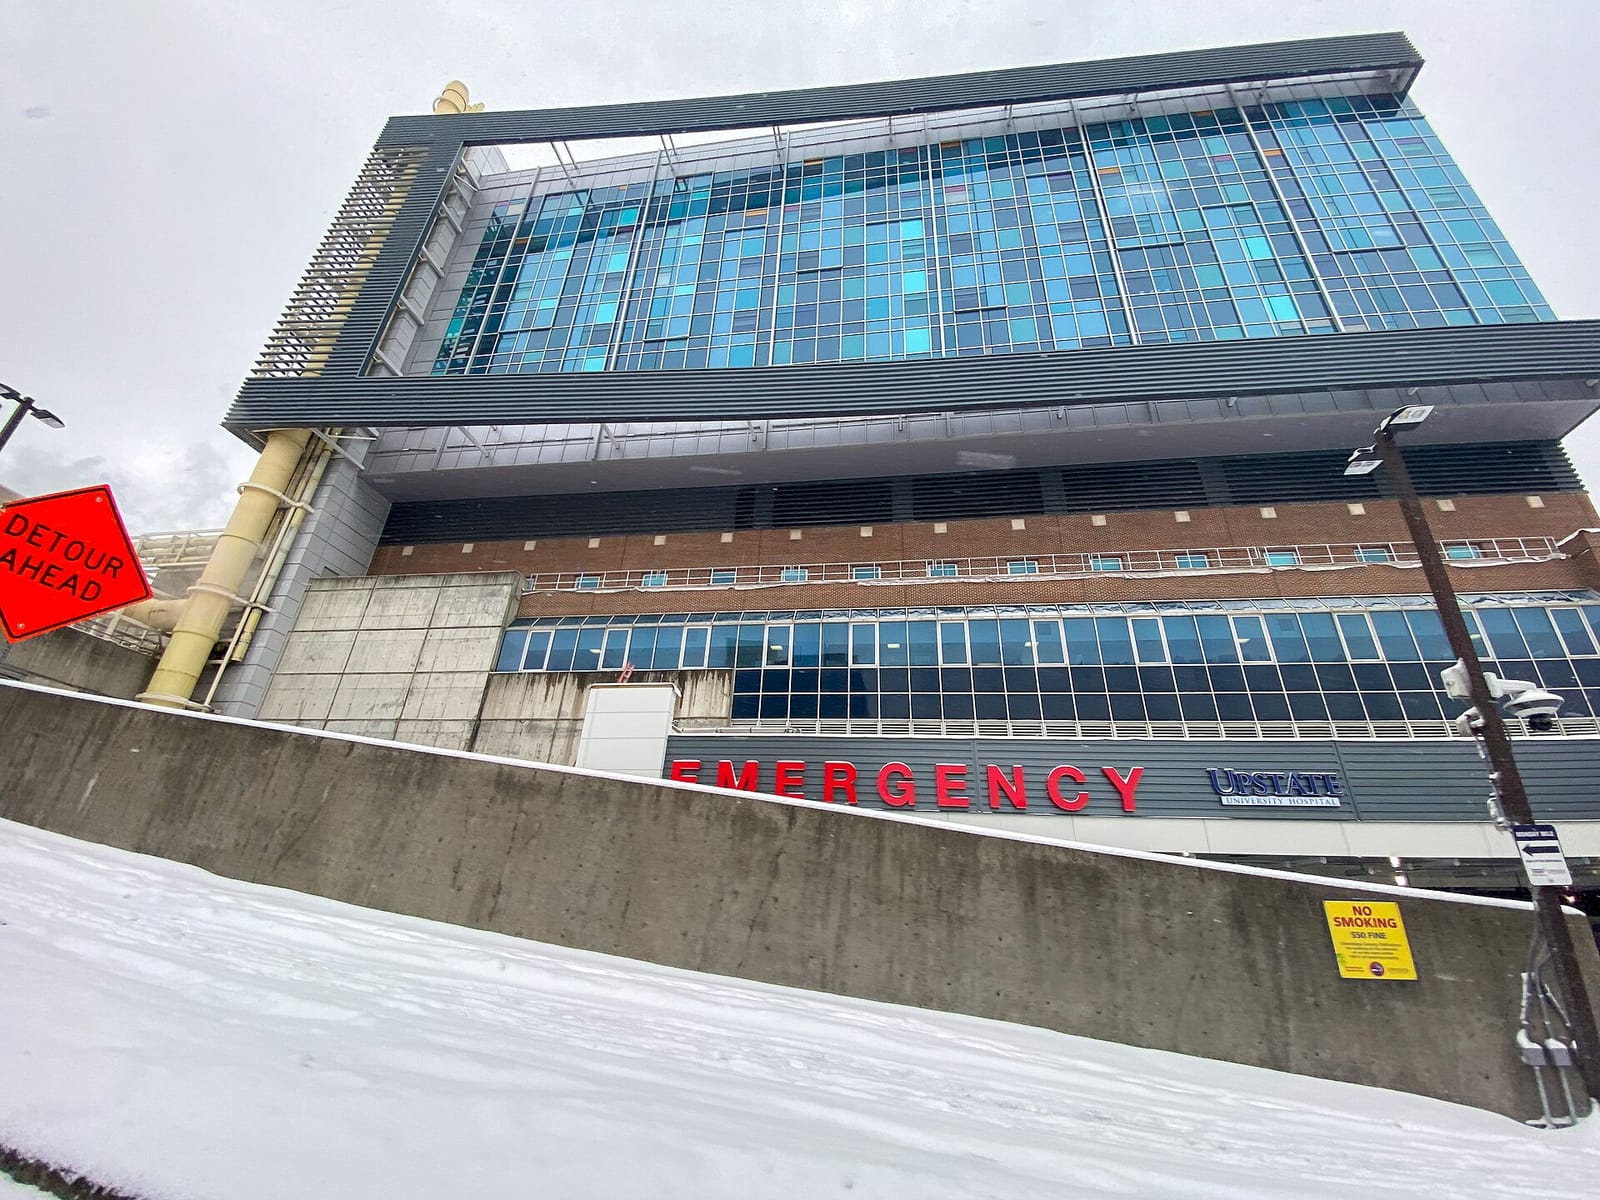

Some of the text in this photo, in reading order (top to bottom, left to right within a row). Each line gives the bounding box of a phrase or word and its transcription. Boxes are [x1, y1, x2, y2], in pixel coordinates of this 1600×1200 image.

[5, 514, 123, 578] DETOUR
[0, 548, 103, 601] AHEAD
[671, 759, 1145, 813] EMERGENCY
[1205, 767, 1344, 797] UPSTATE
[1226, 796, 1338, 806] UNIVERSITY HOSPITAL
[1352, 905, 1373, 917] NO
[1333, 916, 1398, 929] SMOKING
[1368, 932, 1387, 940] FINE
